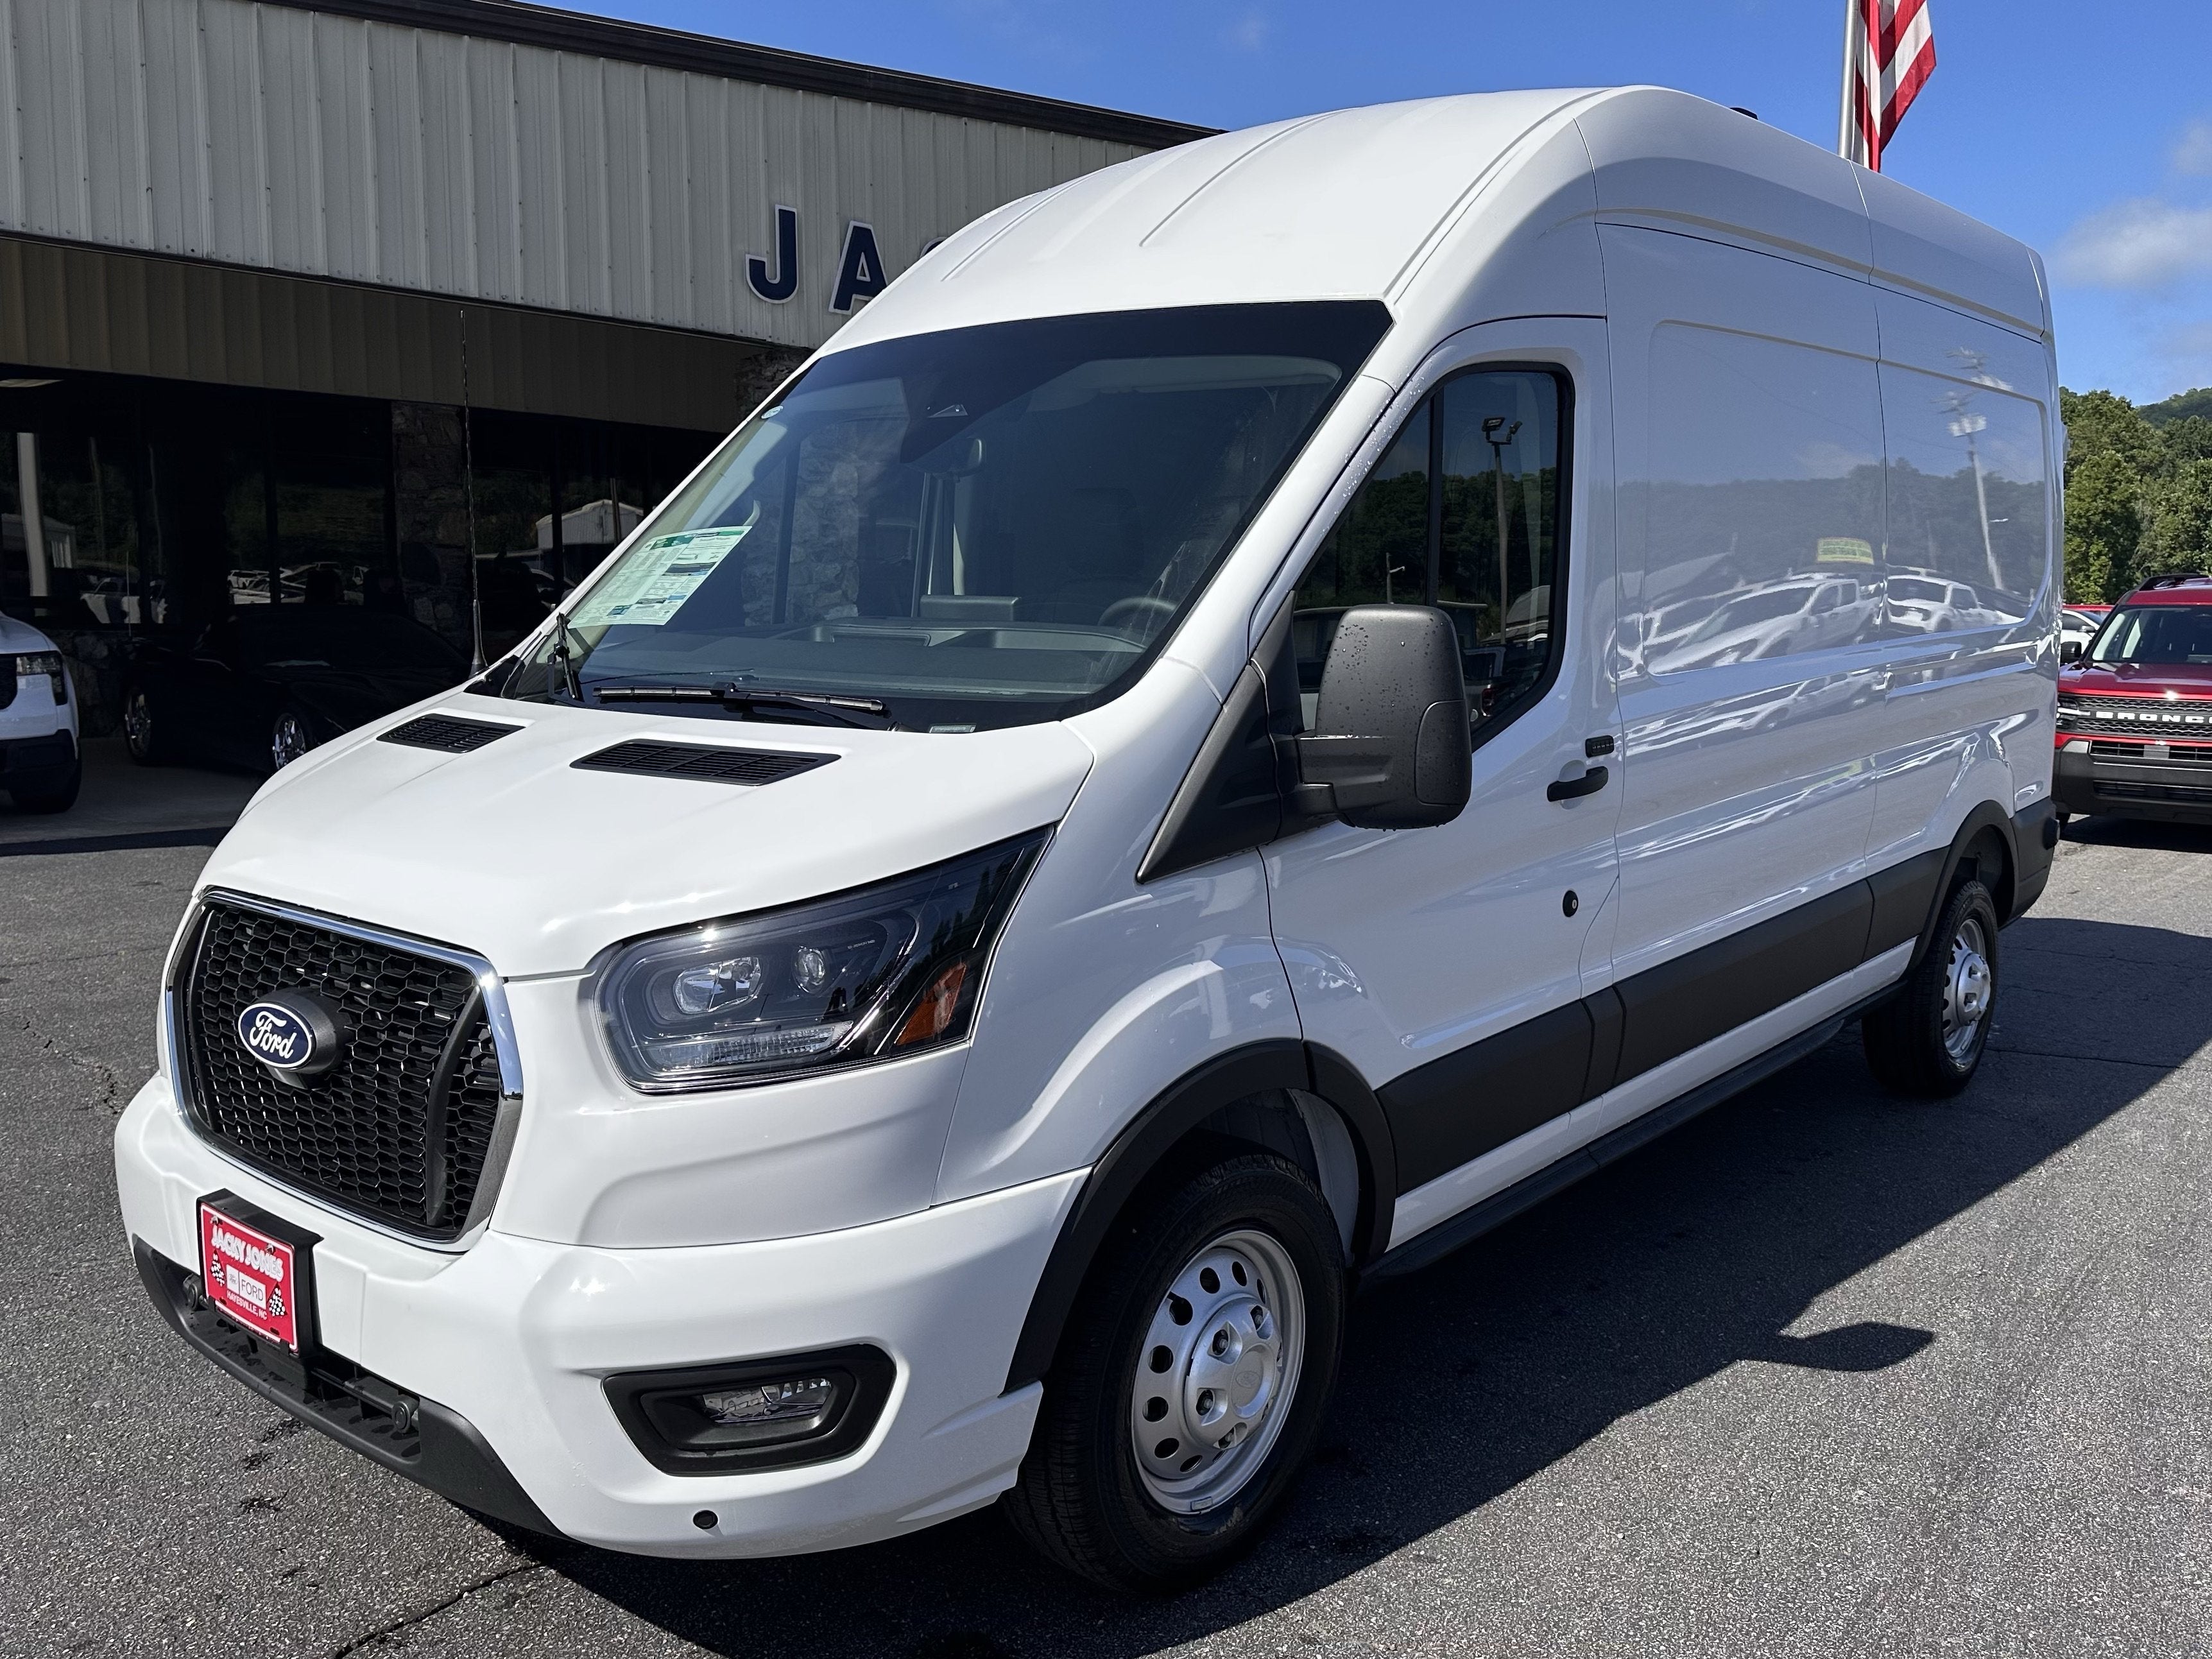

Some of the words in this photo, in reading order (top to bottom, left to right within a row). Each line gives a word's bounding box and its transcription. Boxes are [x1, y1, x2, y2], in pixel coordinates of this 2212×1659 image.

[746, 204, 950, 314] JA
[2096, 711, 2212, 723] BRONC
[249, 1011, 297, 1058] Ford
[211, 1225, 246, 1263] JACKY
[245, 1244, 284, 1282] JONES
[241, 1279, 264, 1302] FORD
